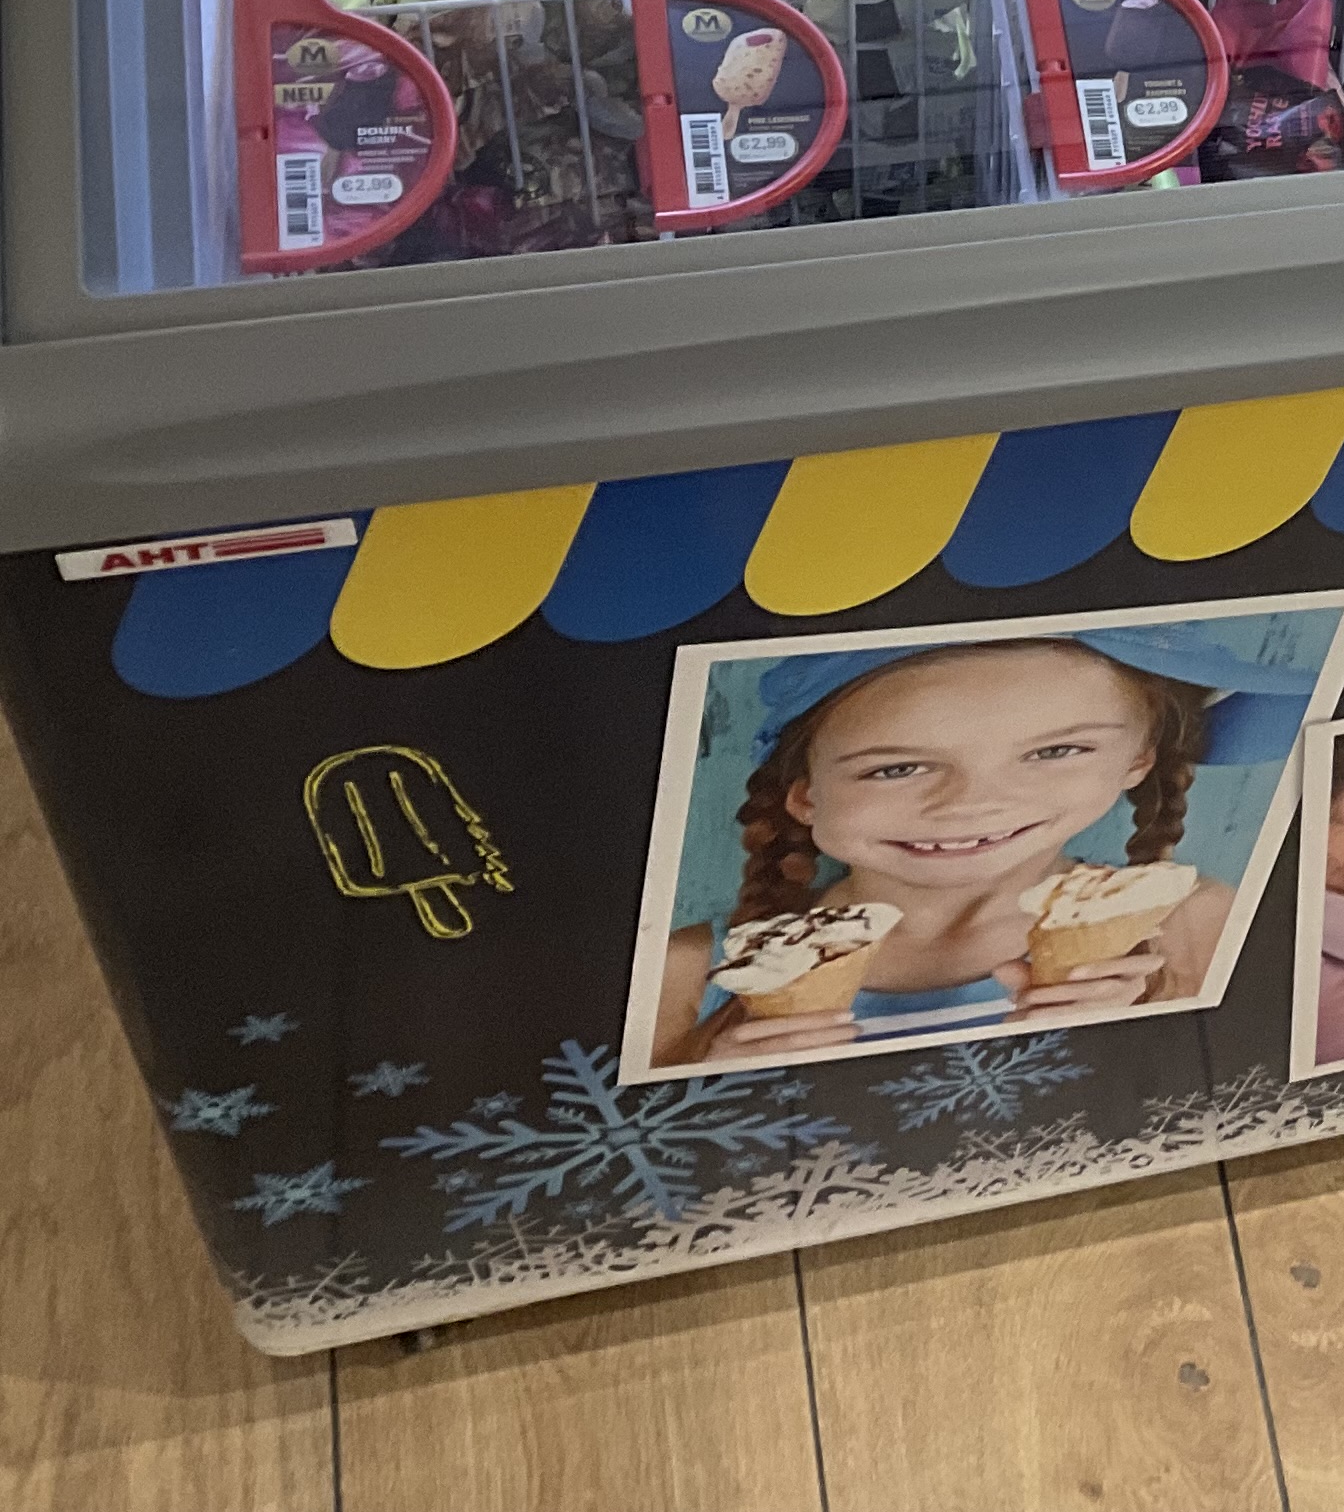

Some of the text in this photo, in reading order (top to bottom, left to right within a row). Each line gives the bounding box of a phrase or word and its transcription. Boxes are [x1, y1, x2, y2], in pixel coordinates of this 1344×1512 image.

[694, 13, 721, 30] M
[301, 43, 327, 63] M
[283, 87, 323, 103] NEU
[357, 125, 413, 136] DOUBLE
[100, 542, 210, 573] AHT
